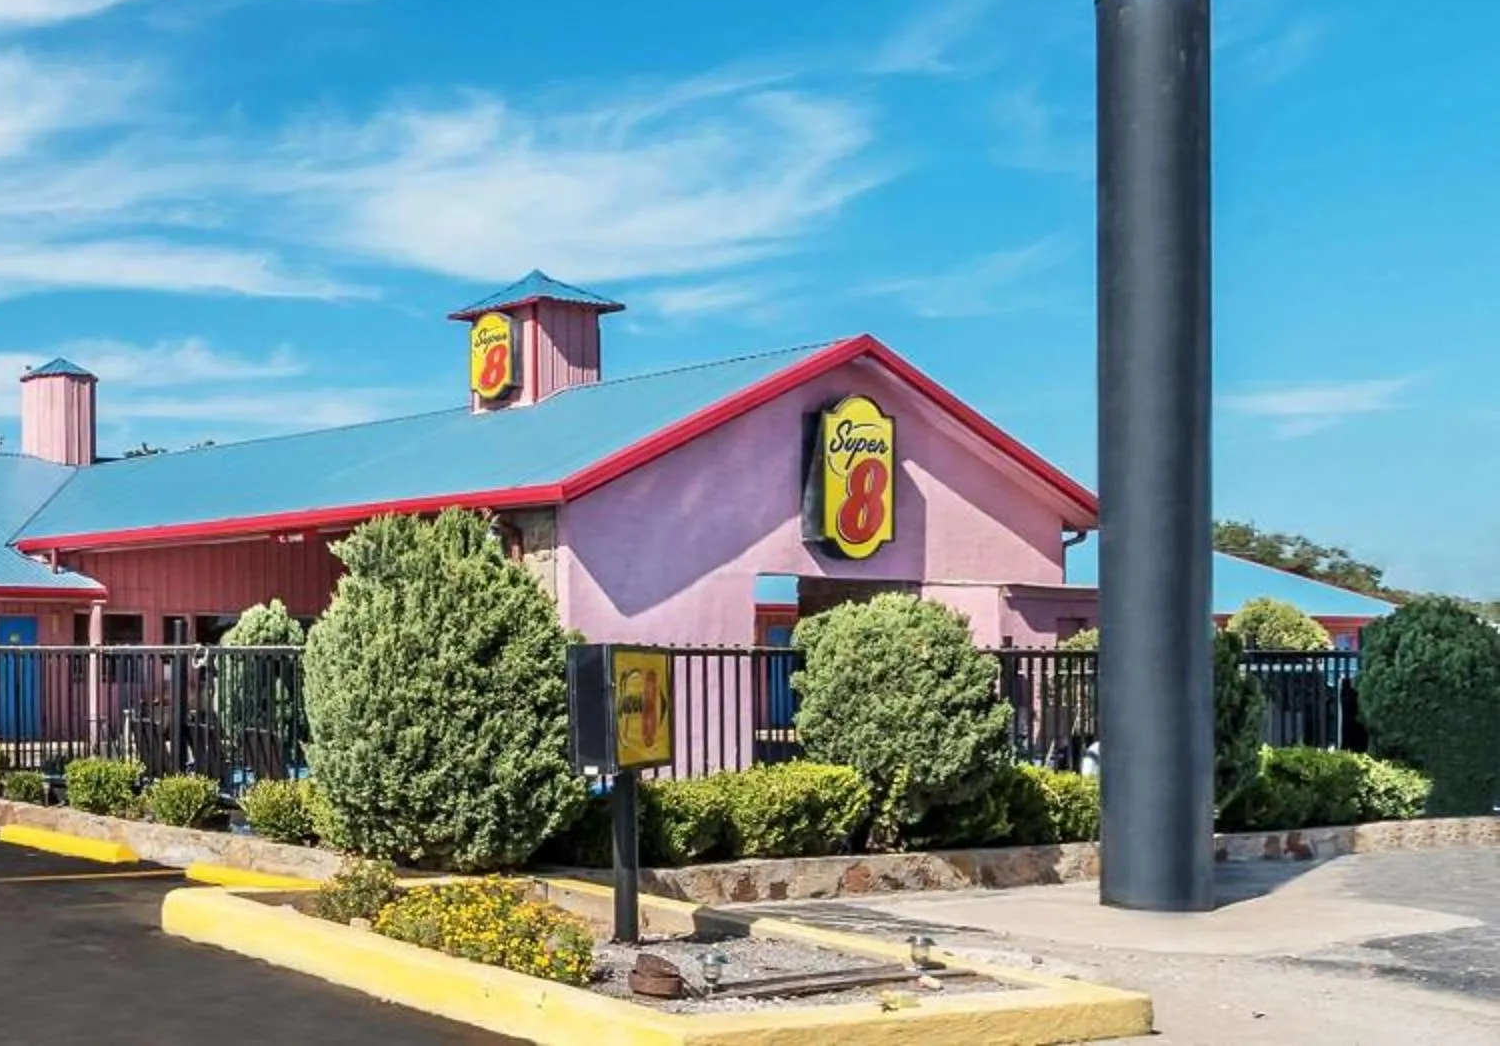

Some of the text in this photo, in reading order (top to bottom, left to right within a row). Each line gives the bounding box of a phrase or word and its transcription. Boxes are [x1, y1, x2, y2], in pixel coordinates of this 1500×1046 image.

[481, 343, 508, 389] 8
[830, 419, 888, 470] Super
[838, 458, 888, 543] 8
